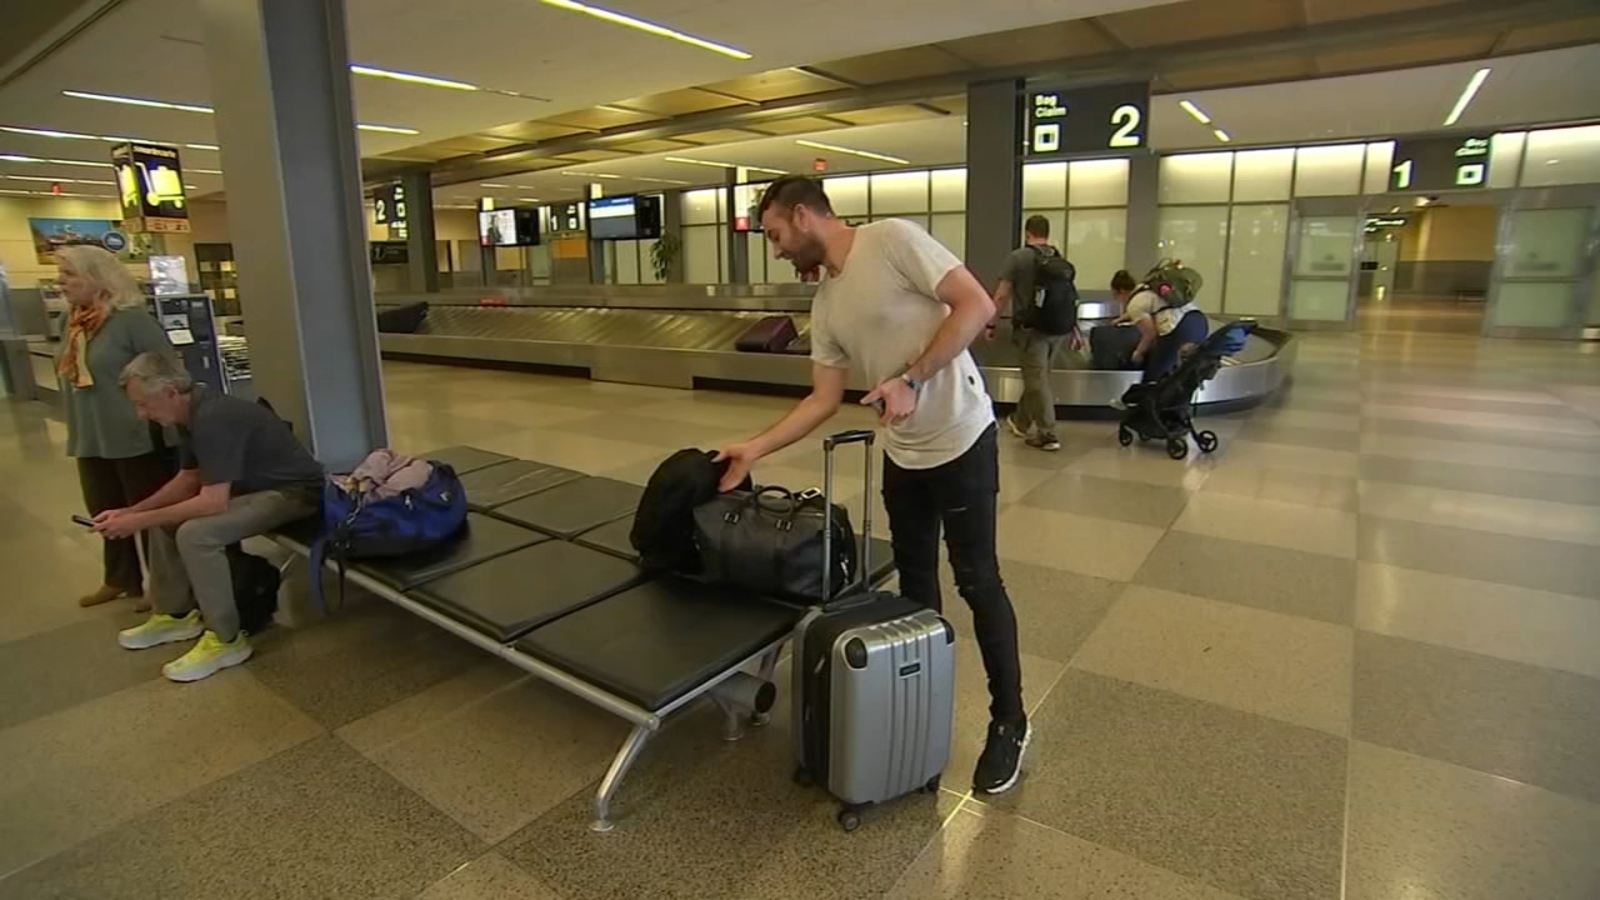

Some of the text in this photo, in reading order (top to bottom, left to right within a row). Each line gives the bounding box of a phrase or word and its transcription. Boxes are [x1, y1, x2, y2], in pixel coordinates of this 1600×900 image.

[1109, 105, 1140, 147] 2
[1393, 160, 1412, 188] 1
[376, 200, 386, 221] 2
[551, 215, 558, 231] 1
